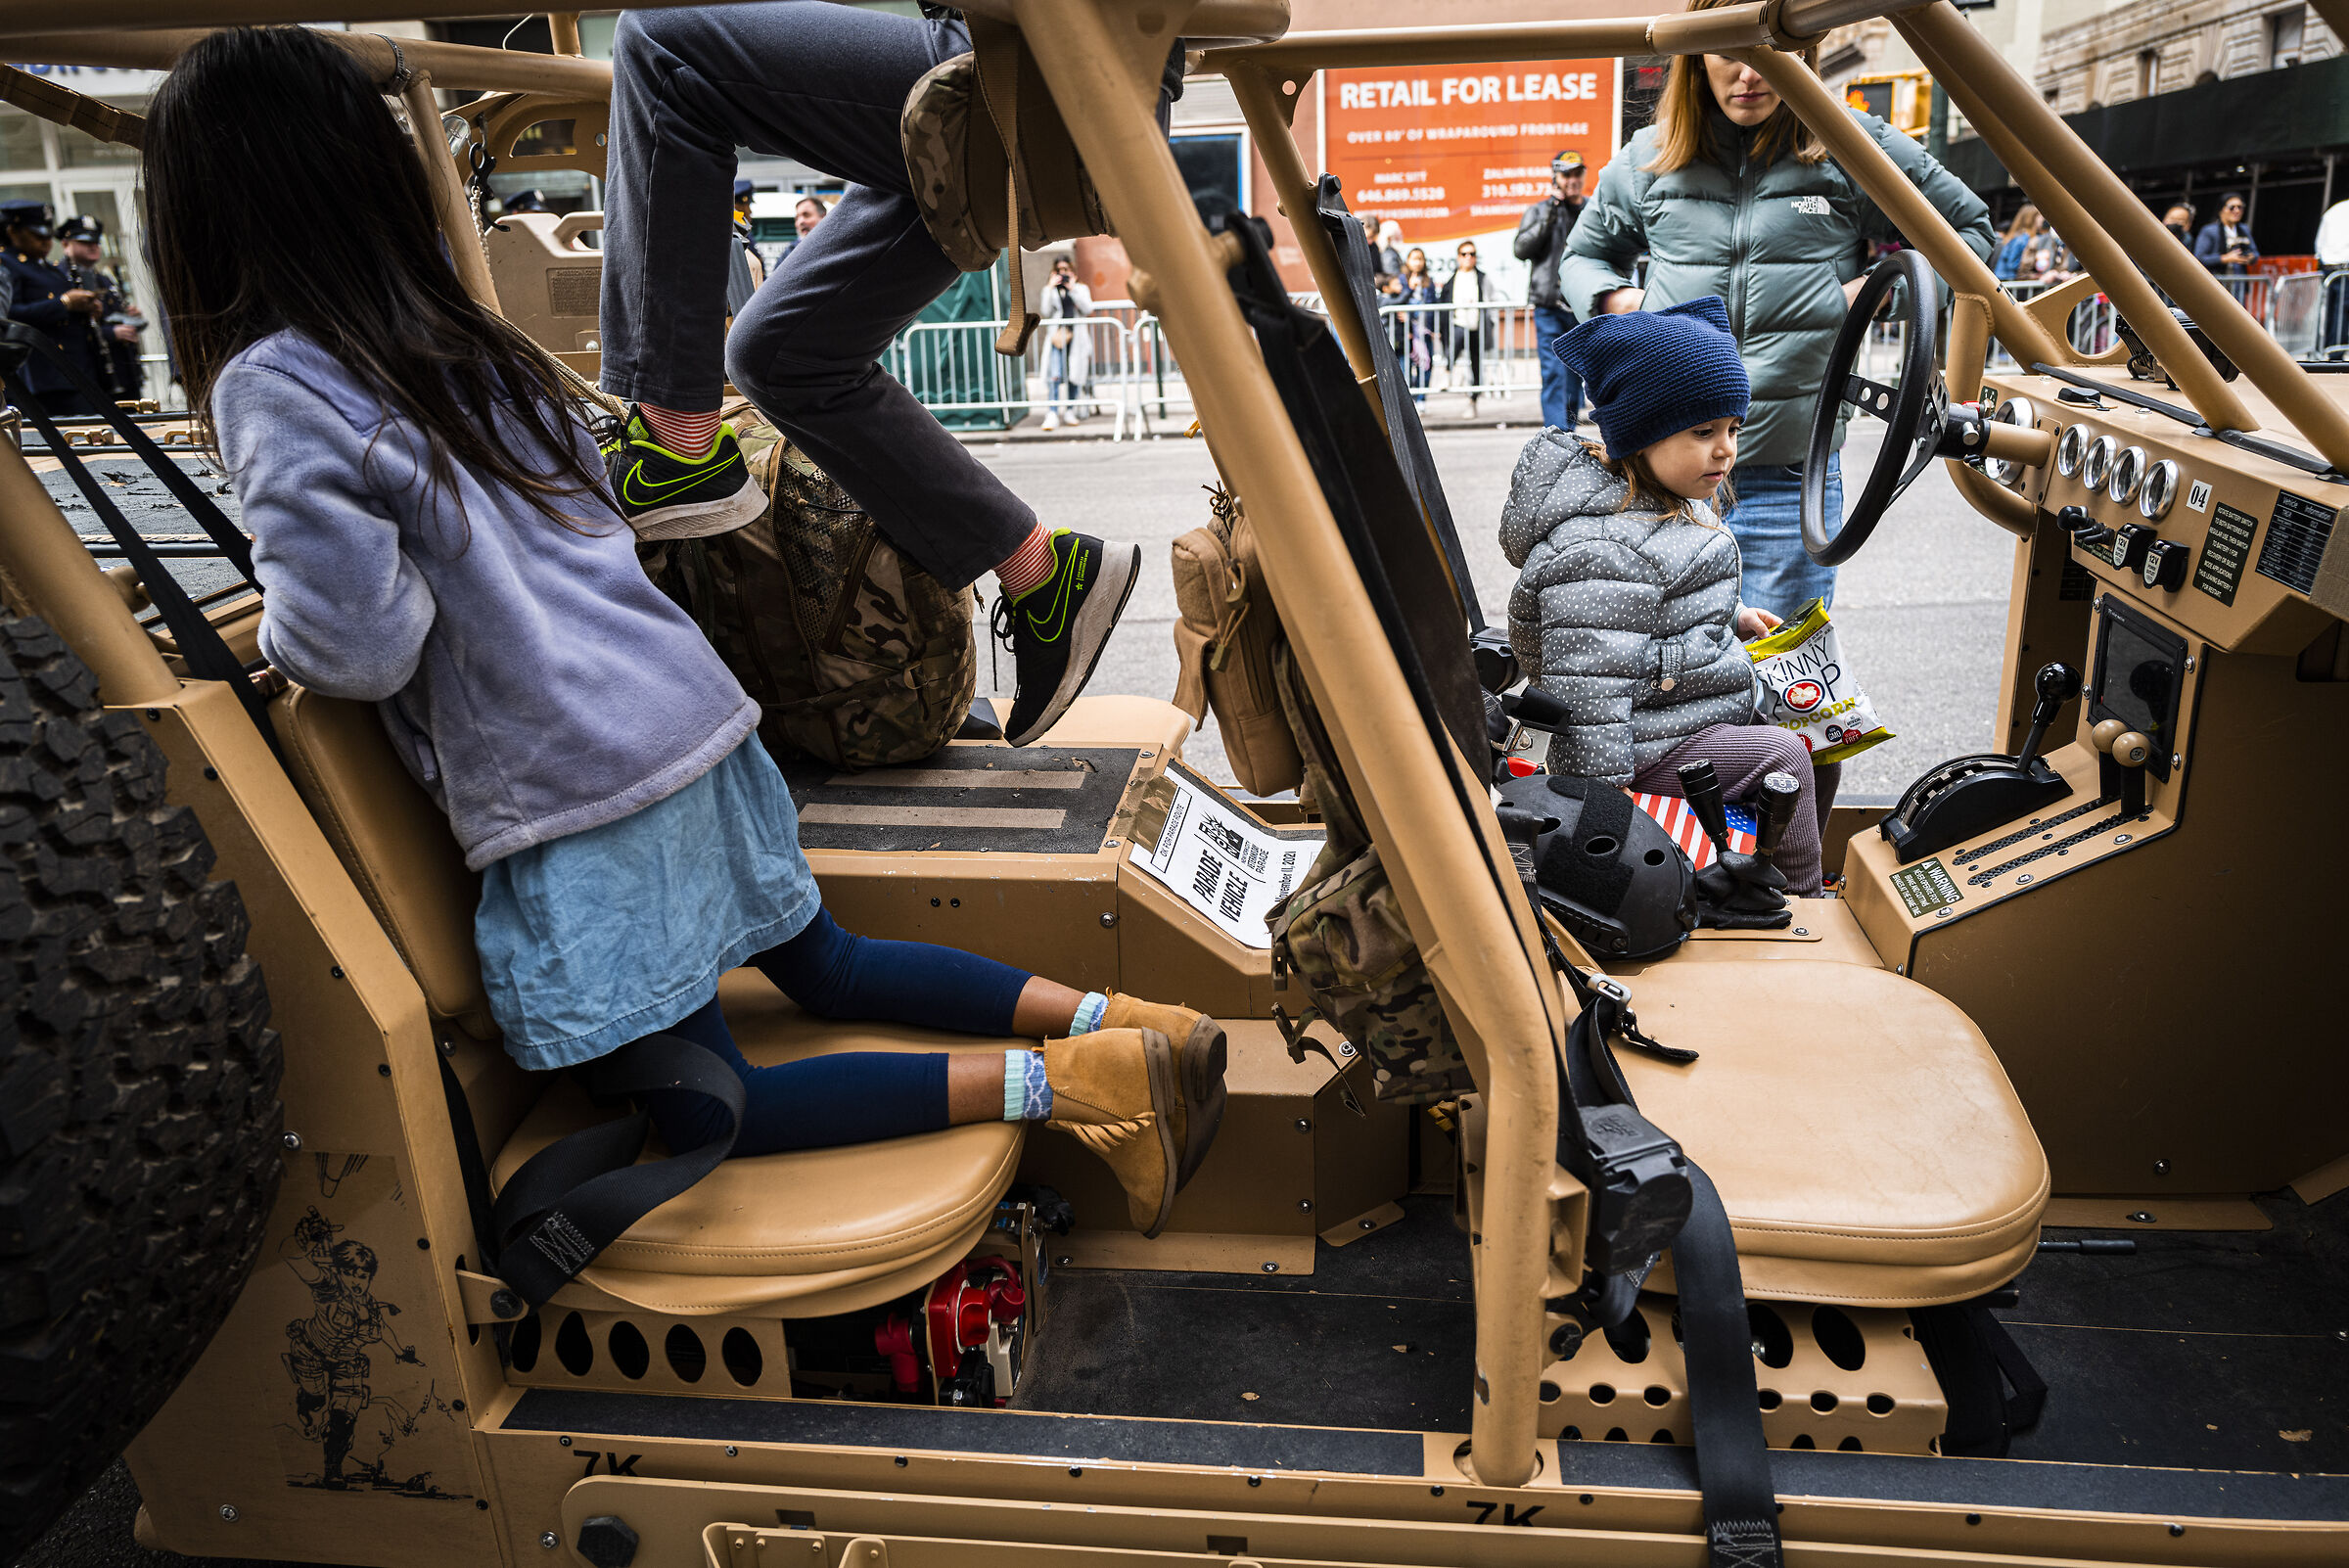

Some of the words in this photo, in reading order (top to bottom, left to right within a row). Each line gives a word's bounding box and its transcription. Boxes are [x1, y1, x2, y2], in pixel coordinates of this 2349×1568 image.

[1340, 79, 1436, 110] RETAIL
[1442, 75, 1502, 106] FOR
[1506, 72, 1597, 102] LEASE
[1347, 131, 1382, 144] OVER
[1406, 128, 1423, 141] OF
[1426, 124, 1518, 140] WRAPAROUND
[1520, 122, 1589, 136] FRONTAGE
[2190, 485, 2207, 508] 04
[2118, 537, 2127, 547] 12V
[2148, 554, 2159, 565] 12V
[1756, 636, 1828, 686] SKINNY
[1827, 730, 1842, 741] GMO
[1845, 734, 1860, 744] FREE
[1174, 804, 1184, 820] ROUTE
[1168, 819, 1179, 838] PARADE
[1160, 848, 1169, 857] OK
[1163, 837, 1172, 849] FOR
[1256, 849, 1269, 874] PARADE
[1282, 852, 1296, 865] 2021
[1192, 849, 1223, 904] PARADE
[1928, 866, 1959, 903] WARNING
[1219, 871, 1249, 923] VEHICLE
[573, 1450, 642, 1477] 7K
[1466, 1500, 1545, 1527] 7K
